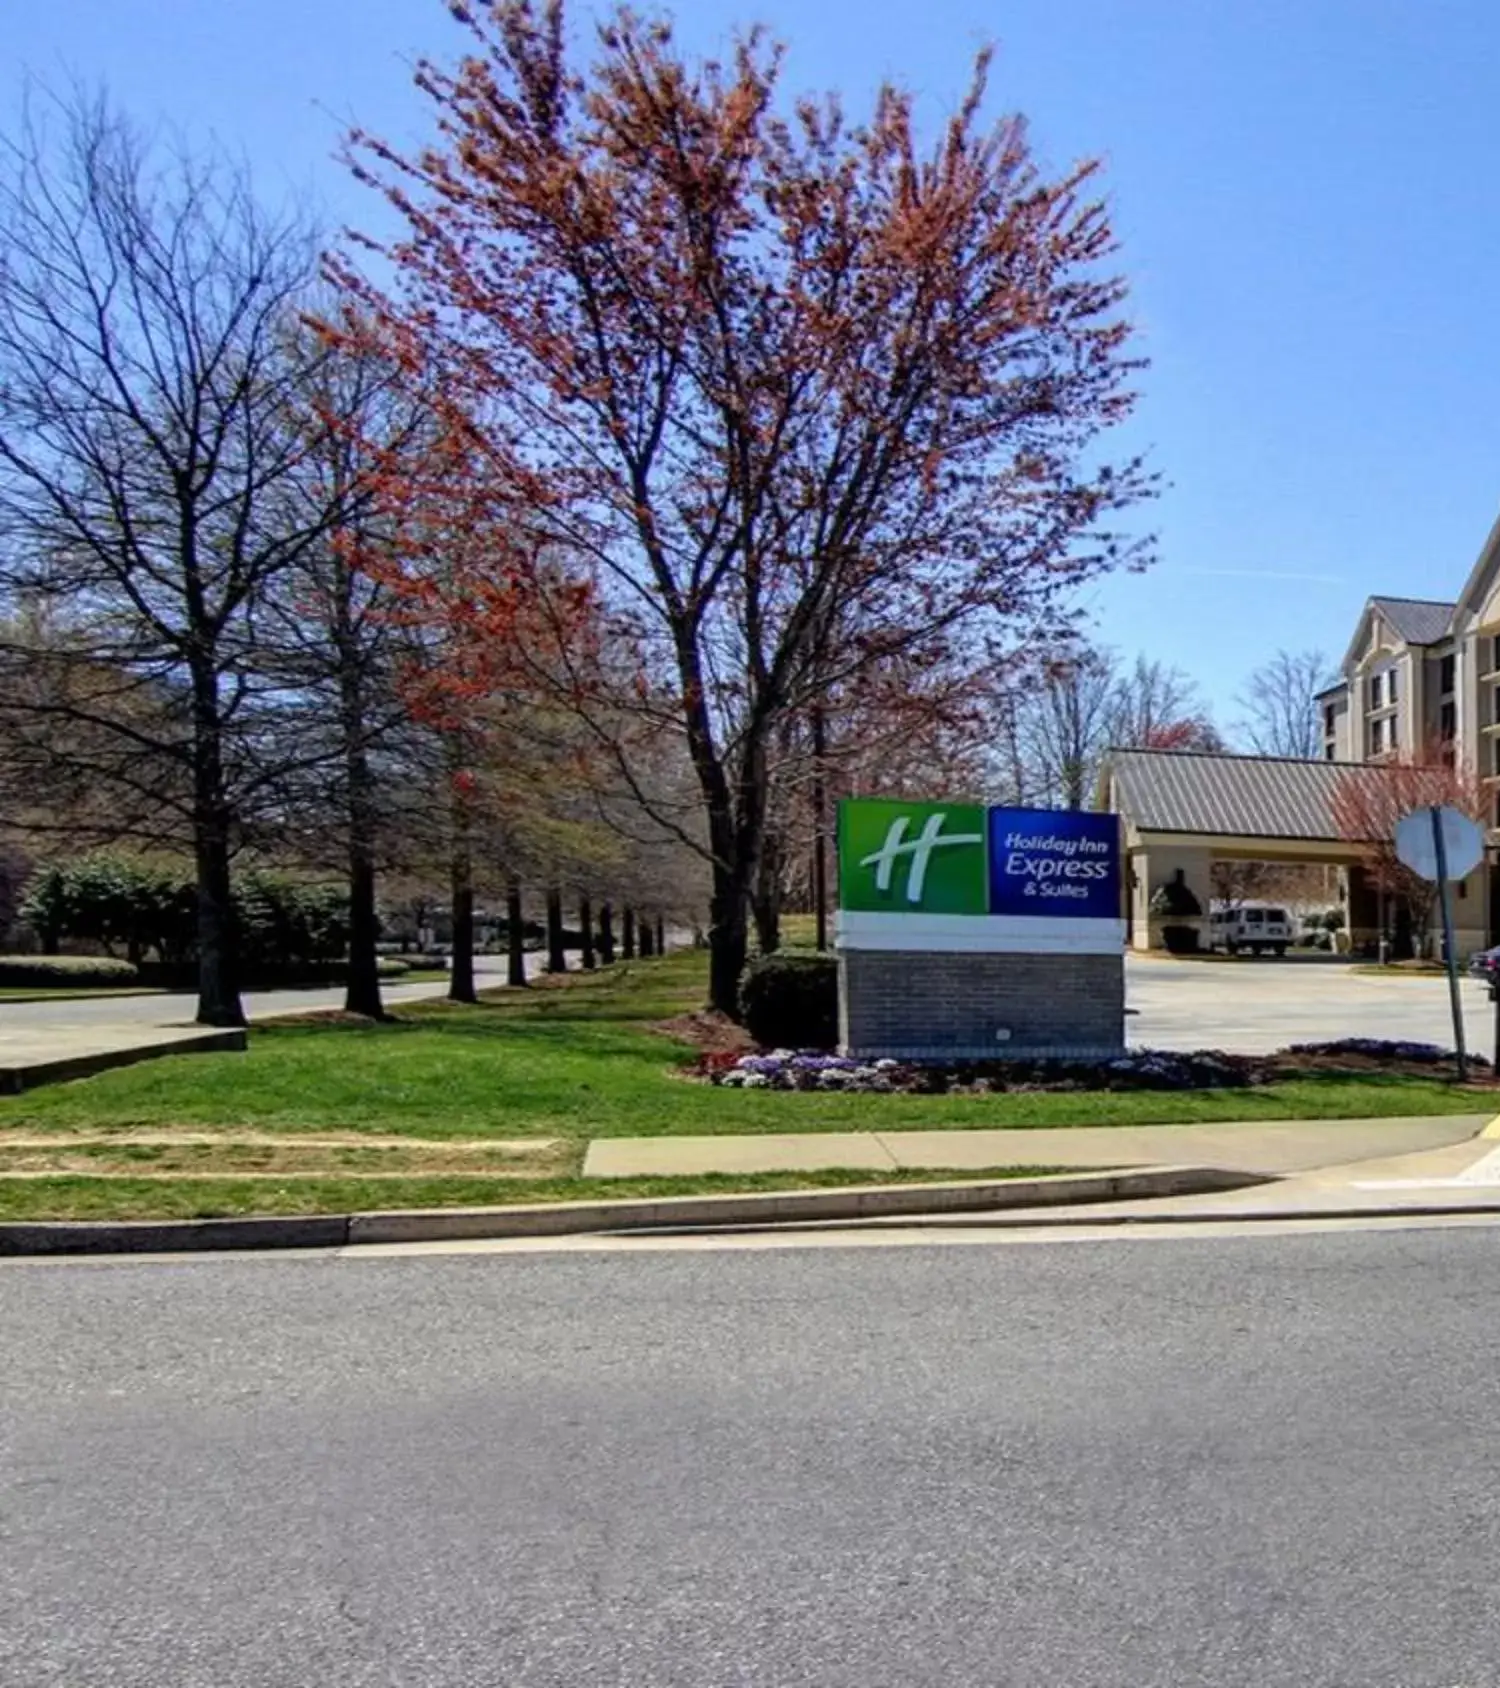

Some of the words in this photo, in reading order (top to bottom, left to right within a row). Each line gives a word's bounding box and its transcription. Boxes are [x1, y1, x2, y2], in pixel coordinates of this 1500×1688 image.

[1005, 832, 1078, 856] Holiday
[1079, 836, 1109, 853] Inn
[1005, 852, 1110, 881] Express
[1023, 881, 1037, 896] &
[1039, 881, 1089, 898] Suites
